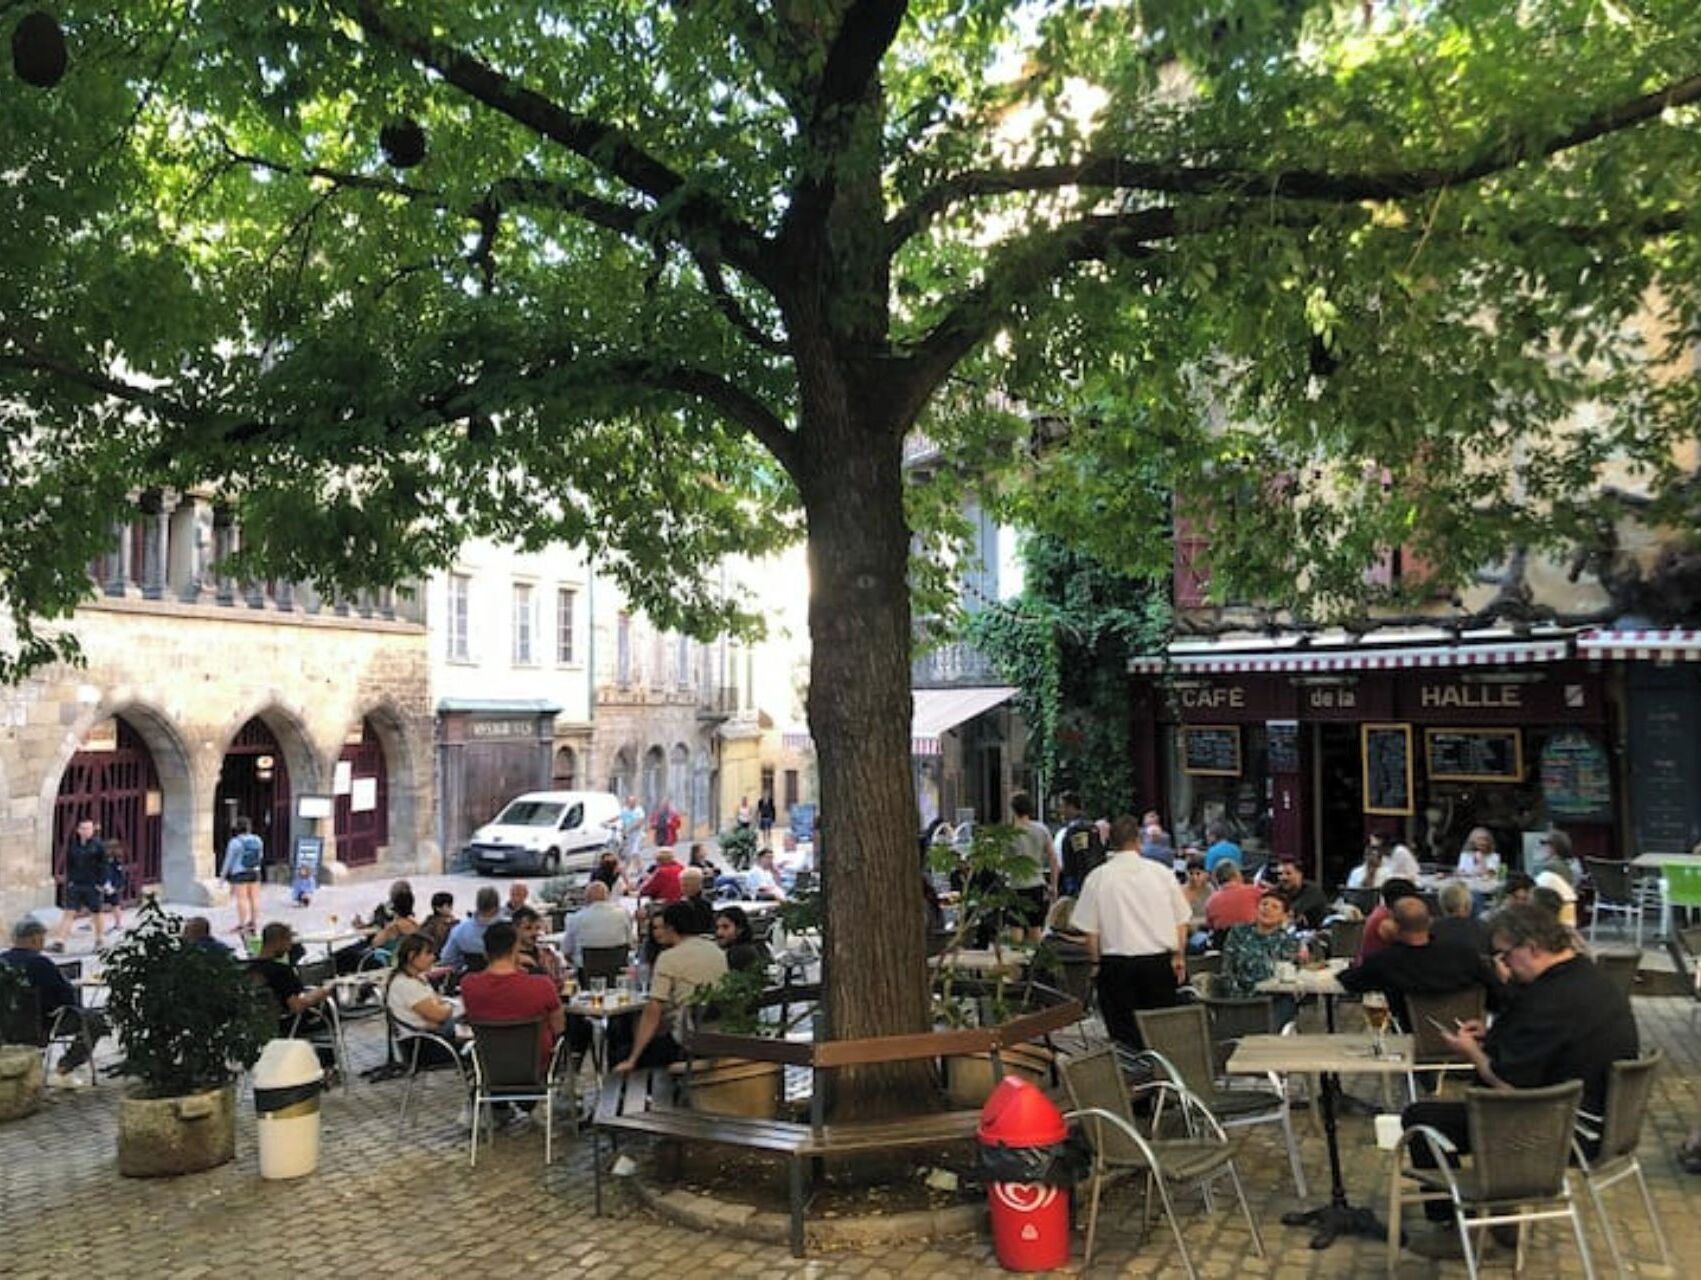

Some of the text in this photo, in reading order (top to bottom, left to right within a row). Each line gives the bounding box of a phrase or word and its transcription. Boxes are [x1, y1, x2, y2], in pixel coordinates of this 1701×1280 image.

[1310, 687, 1334, 707] de
[1338, 687, 1357, 707] la
[1421, 684, 1522, 707] HALLE
